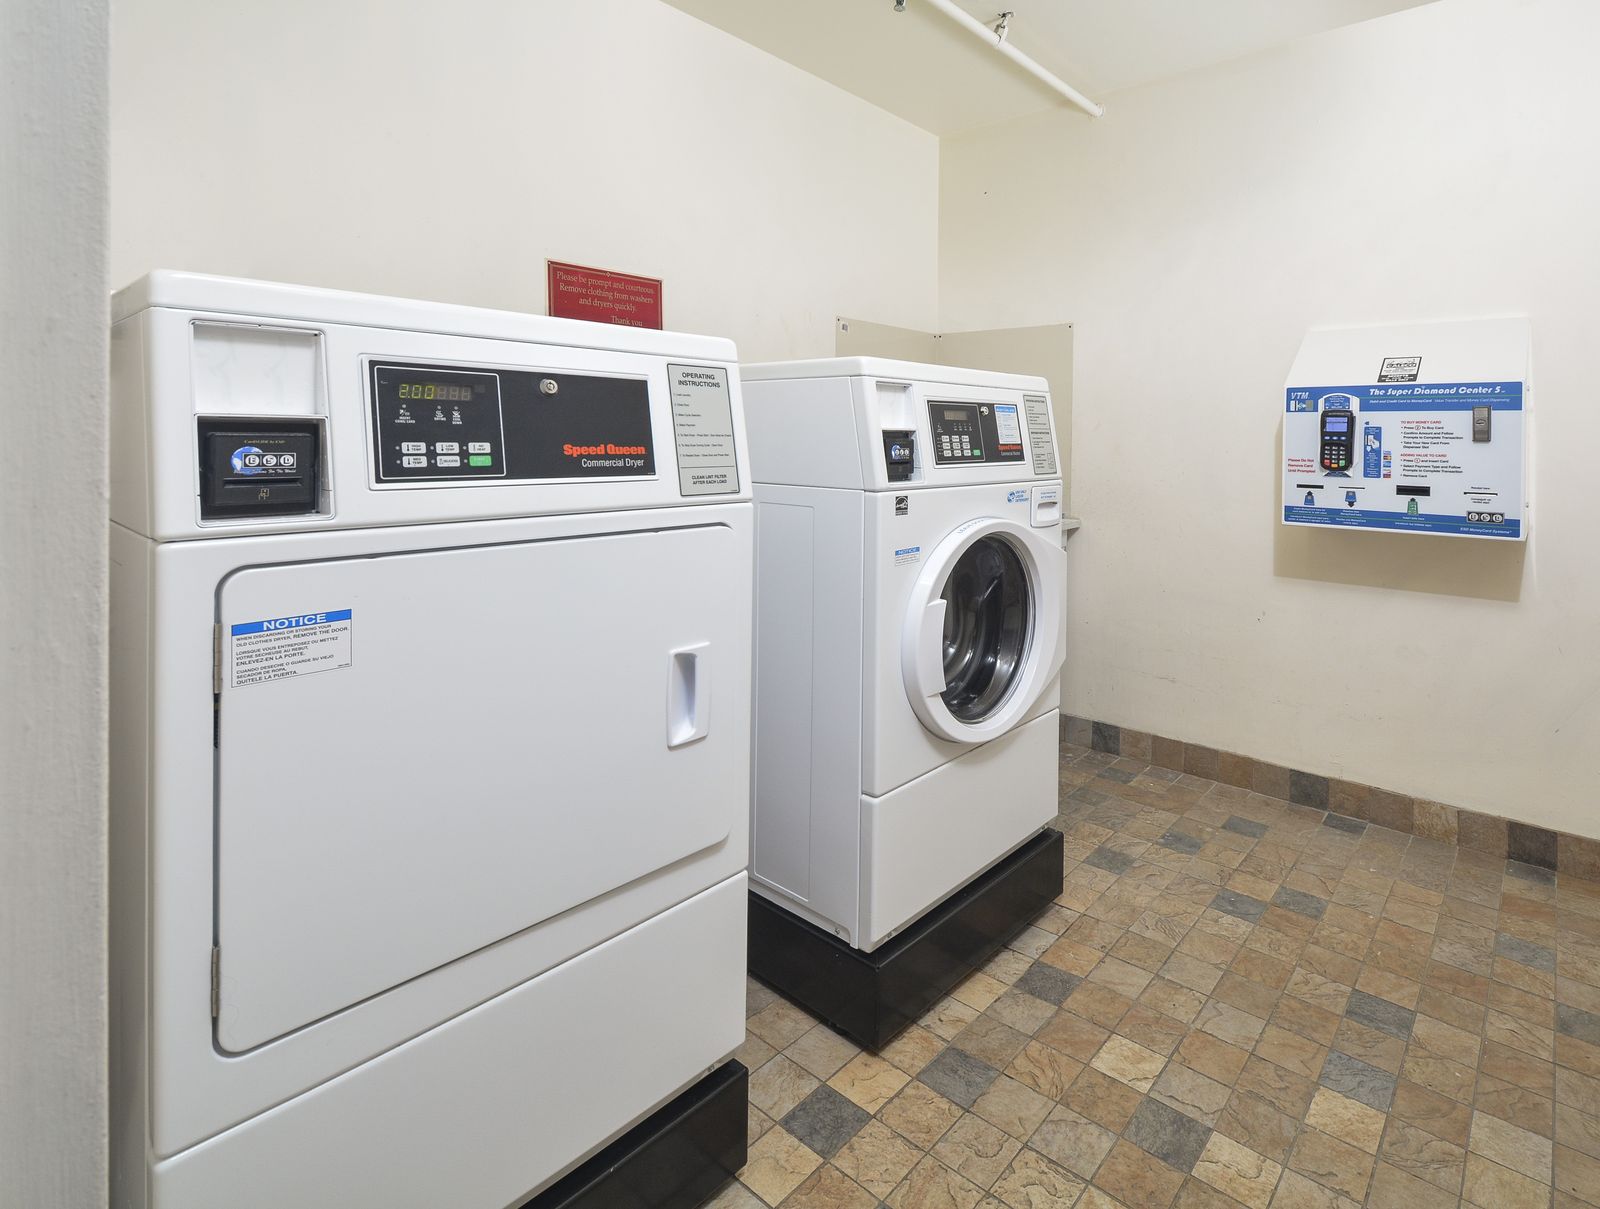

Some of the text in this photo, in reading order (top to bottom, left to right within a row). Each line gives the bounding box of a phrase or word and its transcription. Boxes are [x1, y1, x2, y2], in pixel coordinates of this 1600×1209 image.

[556, 272, 578, 282] Please
[580, 275, 586, 283] be
[588, 279, 612, 289] prompt
[613, 281, 624, 289] and
[560, 283, 654, 304] Remove clothing from washers
[593, 299, 613, 309] dryers
[614, 302, 636, 313] quickly.
[611, 316, 630, 325] Thank
[1387, 388, 1412, 396] Super
[1414, 387, 1456, 395] Diamond
[563, 444, 645, 457] Speed Queen
[582, 458, 644, 468] Commercial Dryer
[263, 614, 326, 631] NOTICE
[253, 631, 285, 639] DISCARDING
[278, 641, 310, 649] ENTREPOSEZ
[236, 656, 274, 666] ENLEVEZ-EN
[236, 676, 262, 685] QUITELE
[273, 670, 298, 678] PUERTA.
